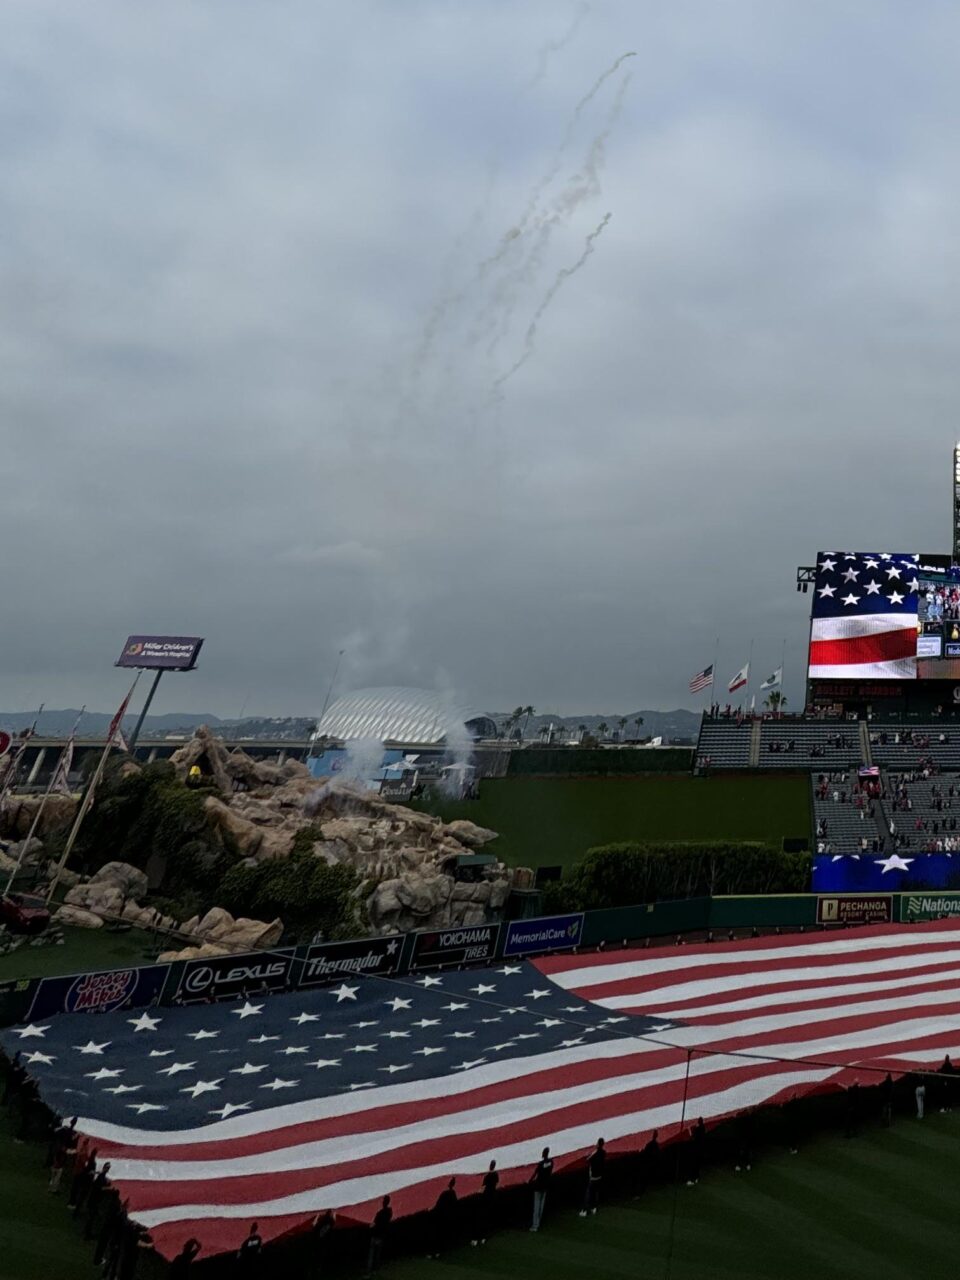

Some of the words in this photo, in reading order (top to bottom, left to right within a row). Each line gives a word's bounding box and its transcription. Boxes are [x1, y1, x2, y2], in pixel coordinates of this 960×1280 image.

[840, 901, 887, 911] PECHANGA
[439, 928, 491, 947] YOKOHAMA
[509, 928, 566, 946] MemorialCare
[464, 945, 489, 960] TIRES
[215, 961, 287, 984] LEXUS
[307, 951, 385, 977] Thermador
[76, 970, 133, 993] Jersey
[73, 987, 126, 1011] Mike's
